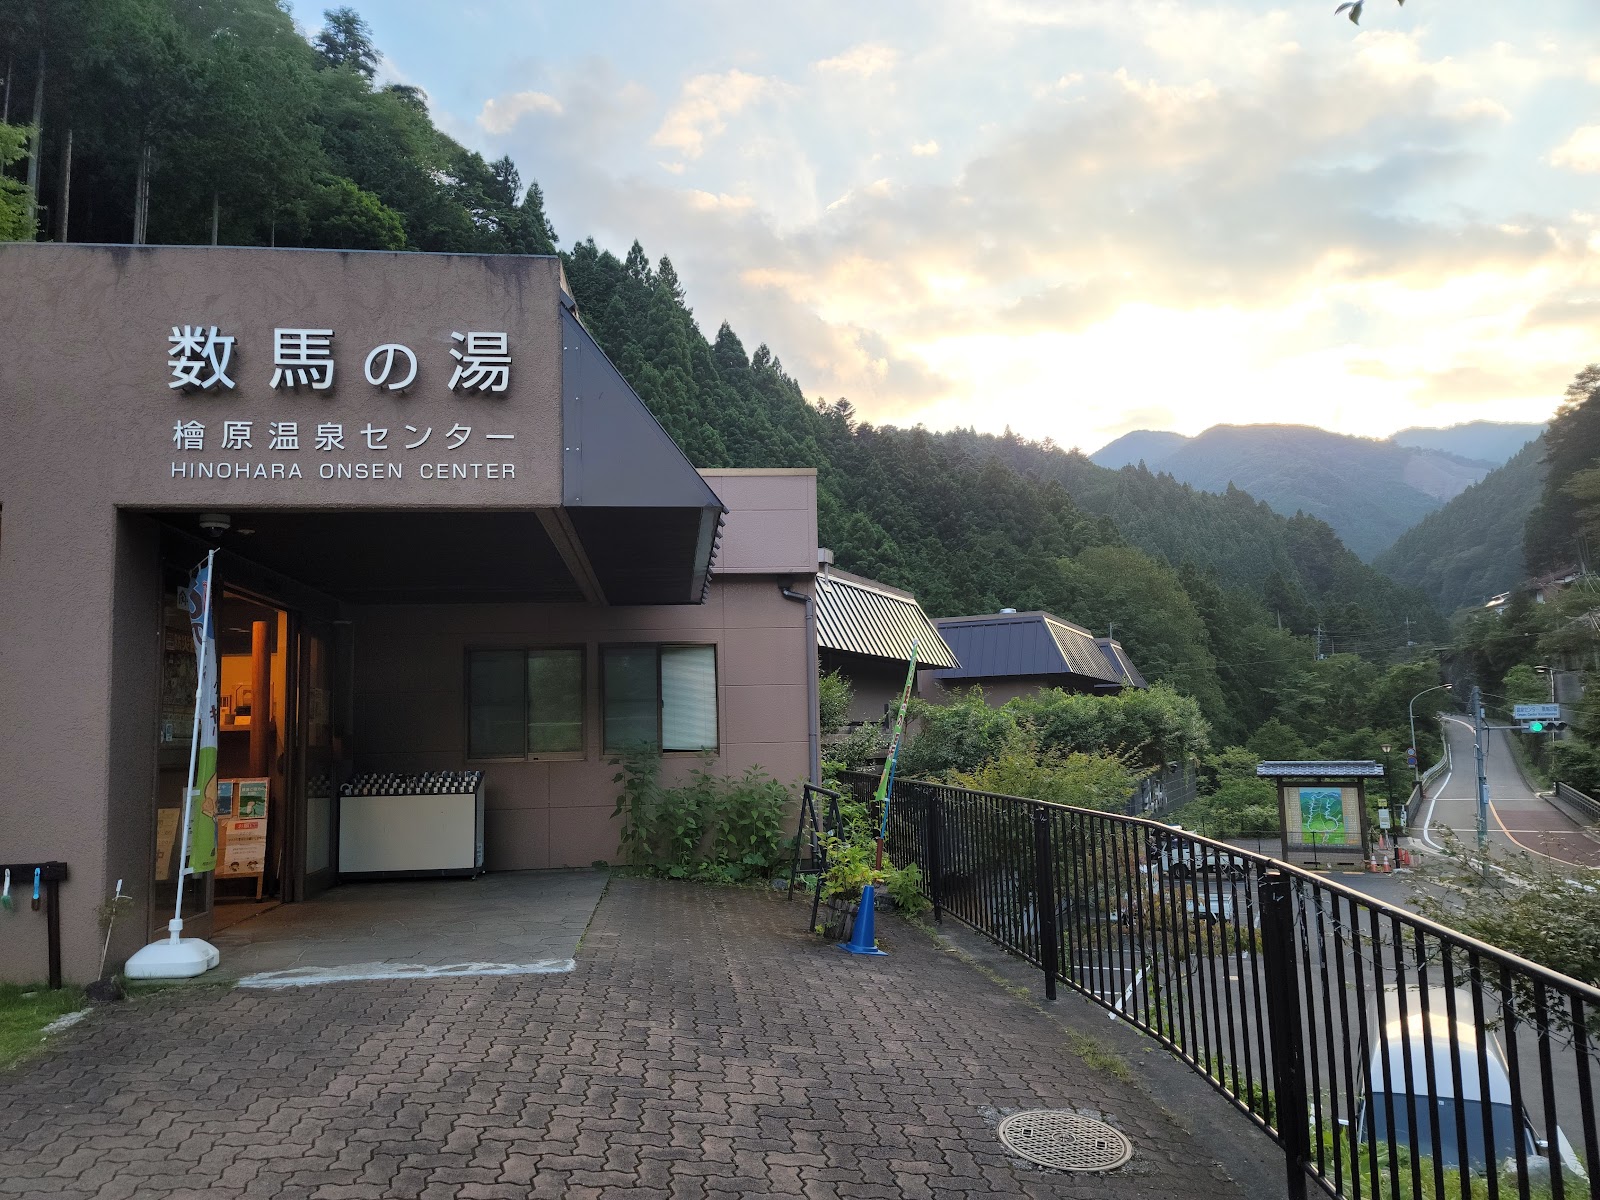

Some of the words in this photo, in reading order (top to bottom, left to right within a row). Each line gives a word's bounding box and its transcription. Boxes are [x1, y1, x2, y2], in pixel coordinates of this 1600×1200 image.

[167, 324, 512, 392] 数馬の湯
[172, 419, 515, 451] 檜原温泉センター
[170, 462, 303, 479] HINOHARA
[319, 462, 402, 479] ONSEN
[420, 463, 516, 479] CENTER
